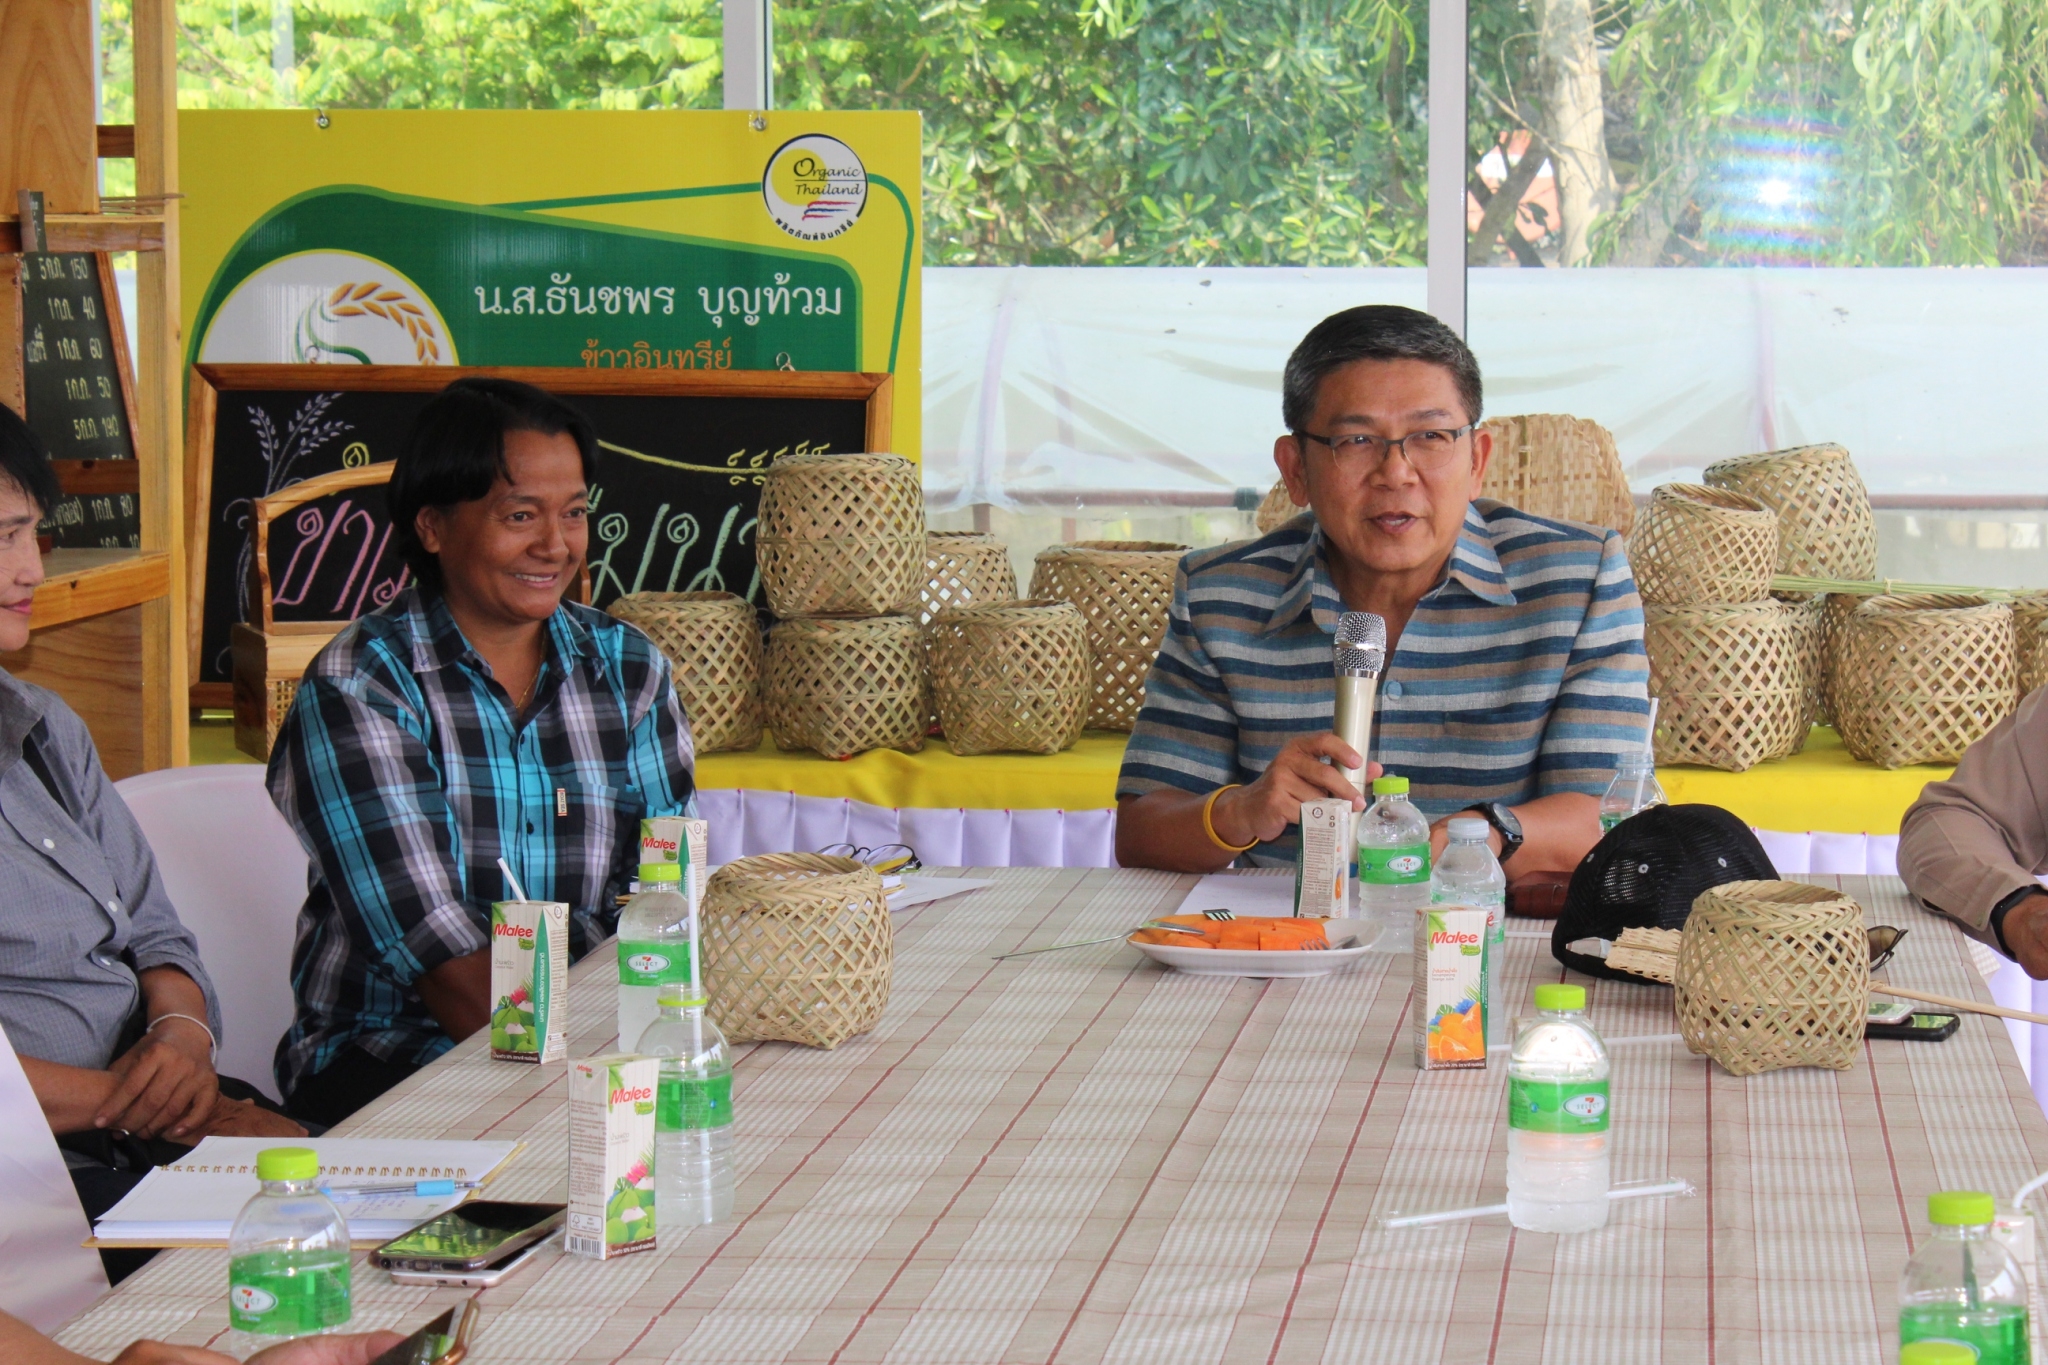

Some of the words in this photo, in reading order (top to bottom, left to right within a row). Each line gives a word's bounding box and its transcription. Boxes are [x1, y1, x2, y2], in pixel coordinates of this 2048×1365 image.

[793, 157, 861, 181] Organic
[796, 183, 863, 196] Thailand
[70, 257, 88, 280] 150
[82, 296, 97, 320] 40
[474, 272, 676, 316] น.ส.ธันชพร
[697, 272, 843, 328] บุญท้วม
[89, 337, 103, 360] 60
[580, 336, 732, 370] ข้าวอินทรีย์
[97, 376, 112, 399] 50
[102, 414, 120, 438] 190
[120, 494, 133, 518] 80
[642, 837, 677, 850] Malee
[494, 924, 533, 938] Malee
[1431, 931, 1478, 944] Malee
[610, 1086, 652, 1105] Malee
[1576, 1102, 1600, 1110] SELECT
